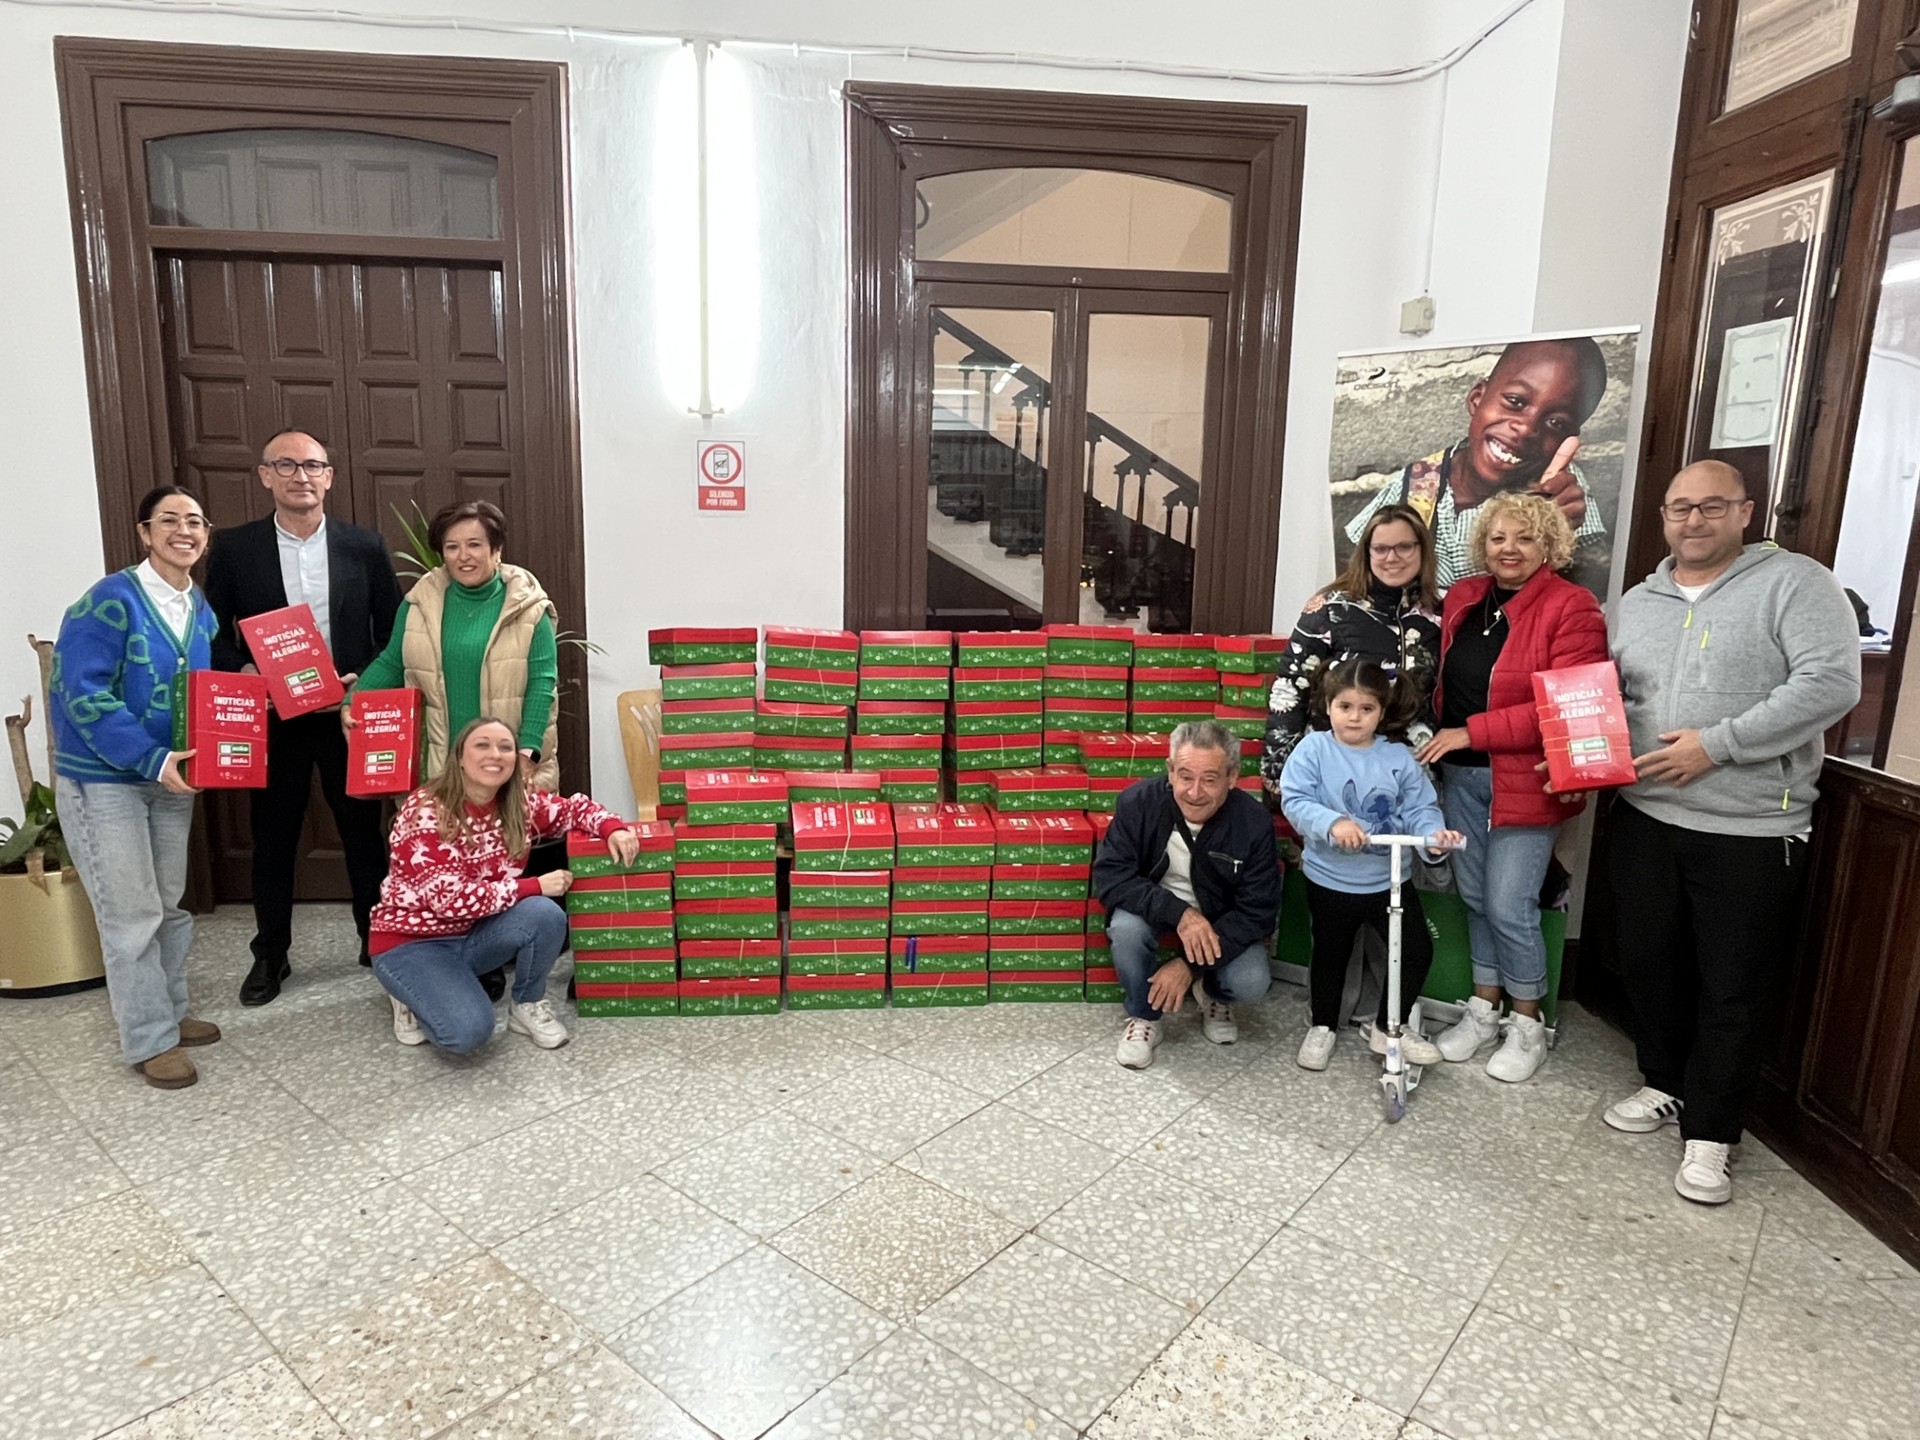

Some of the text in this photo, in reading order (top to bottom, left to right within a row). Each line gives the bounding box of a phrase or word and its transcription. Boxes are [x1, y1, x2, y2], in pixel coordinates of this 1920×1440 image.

[271, 641, 310, 660] ALEGRÍA!
[215, 712, 254, 722] ALEGRÍA!
[1560, 705, 1606, 720] ALEGRÍA!
[365, 724, 400, 734] ALEGRÍA!
